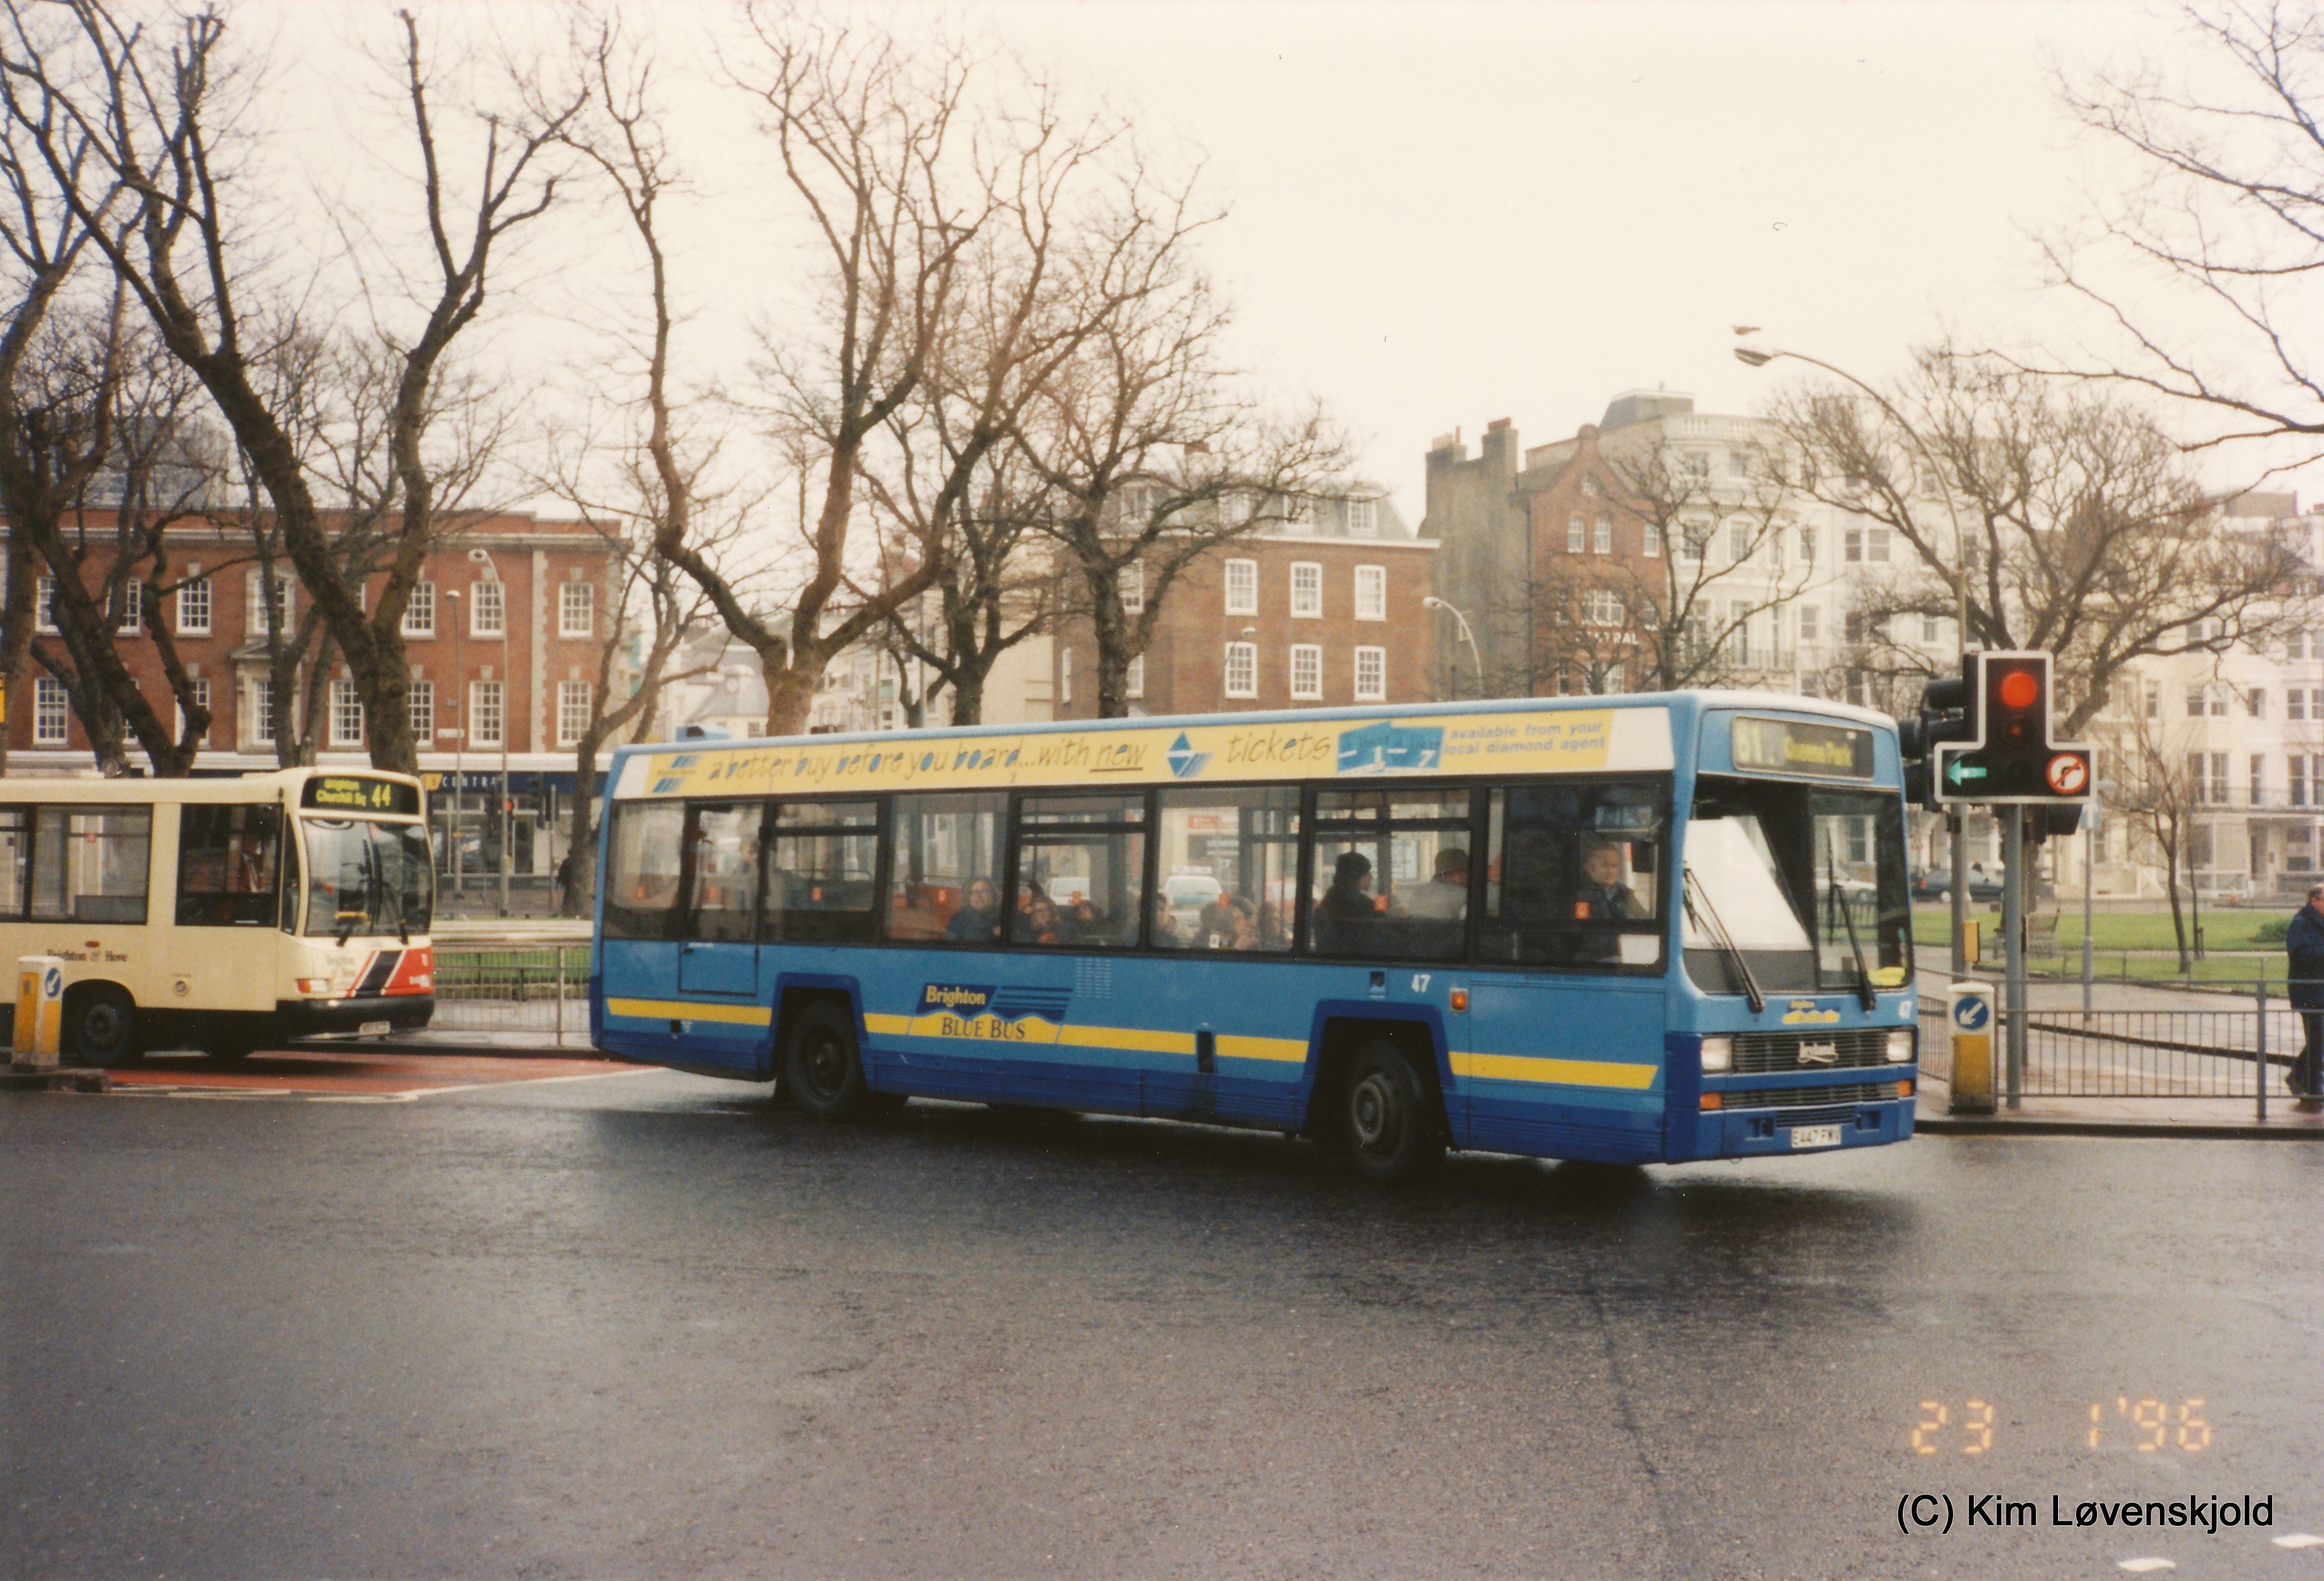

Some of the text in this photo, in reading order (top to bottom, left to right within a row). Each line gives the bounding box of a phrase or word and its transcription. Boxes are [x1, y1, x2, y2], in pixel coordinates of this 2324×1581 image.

[1450, 722, 1602, 740] available from your
[710, 761, 723, 781] a
[726, 752, 793, 780] better
[795, 749, 832, 784] buy
[836, 743, 904, 775] before
[904, 749, 950, 781] you
[1094, 743, 1148, 767] new
[1228, 729, 1330, 763] tickets
[1445, 741, 1480, 755] local
[1486, 739, 1554, 753] diamond
[1560, 737, 1606, 753] agent
[371, 784, 391, 808] 44
[1411, 974, 1431, 993] 47
[926, 985, 986, 1007] Brighton
[941, 1017, 1026, 1040] BLUE BUS
